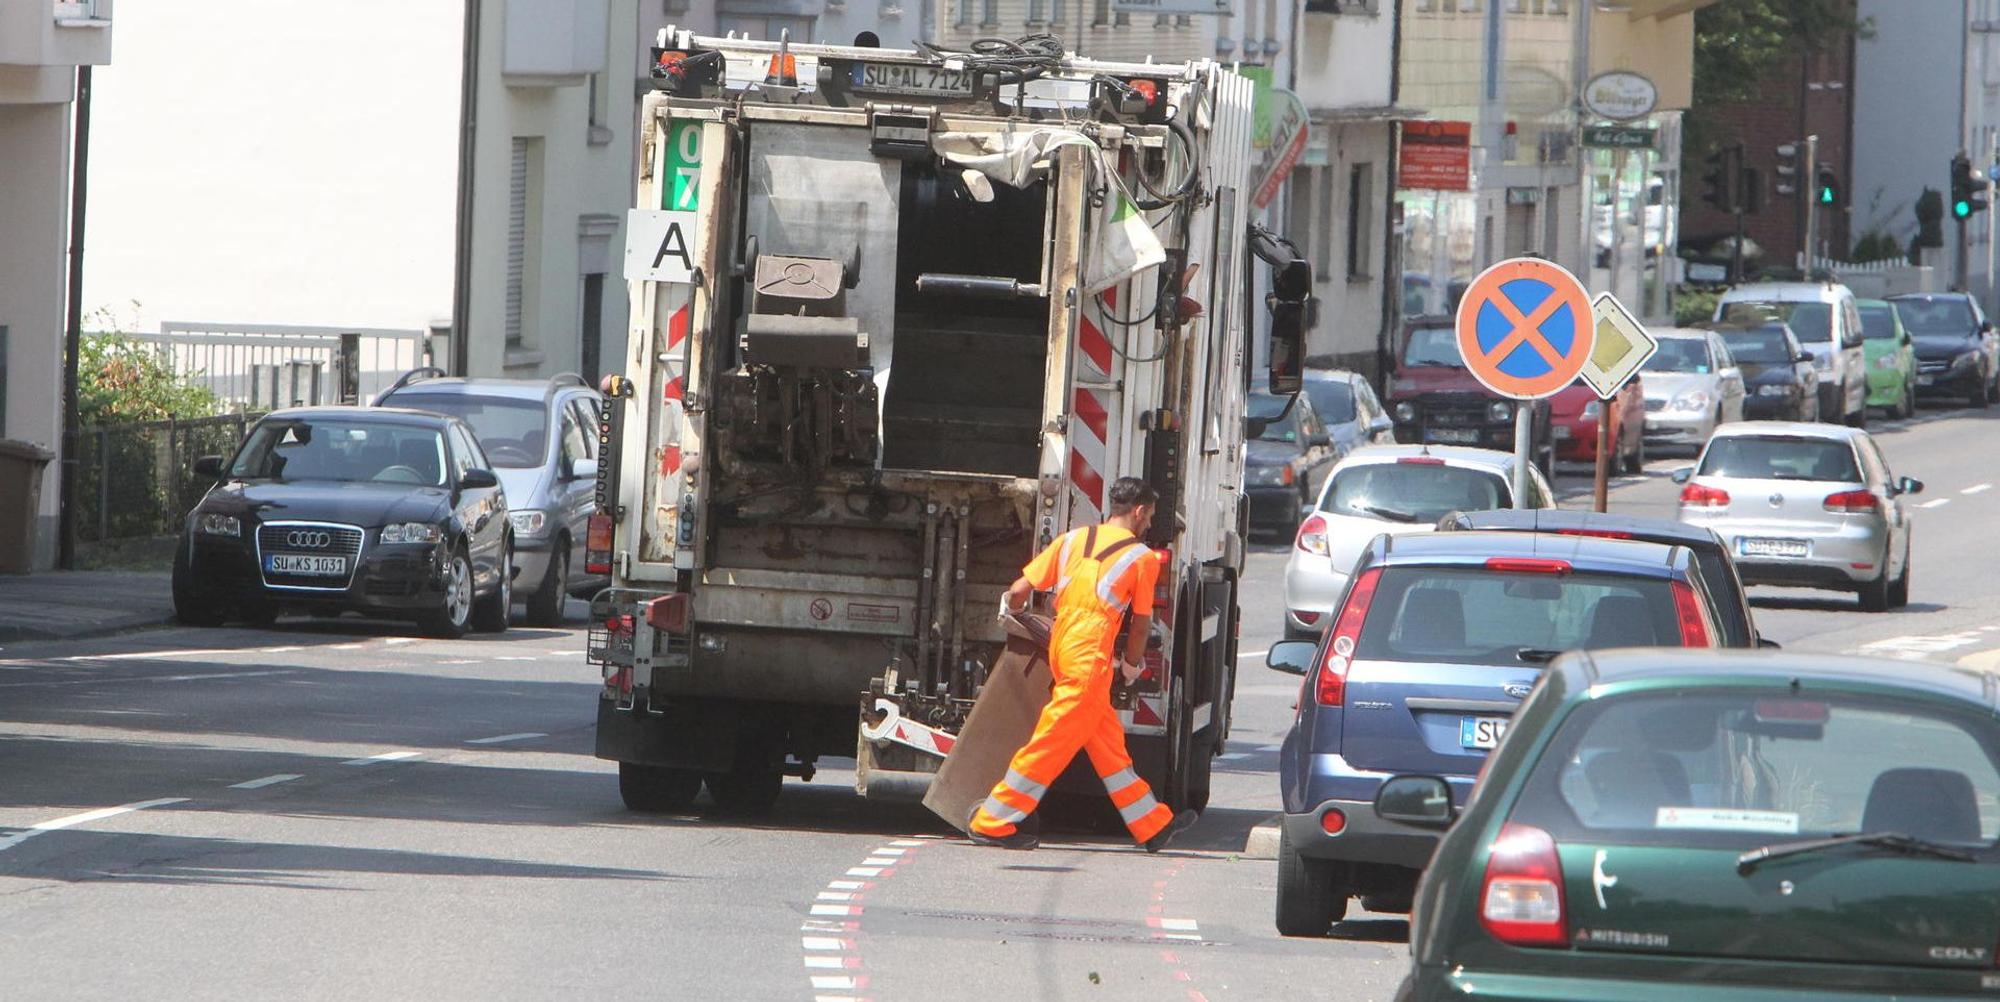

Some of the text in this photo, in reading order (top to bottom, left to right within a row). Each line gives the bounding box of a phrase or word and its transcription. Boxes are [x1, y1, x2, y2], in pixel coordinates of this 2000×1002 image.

[865, 65, 970, 91] SU AL 7124
[651, 222, 693, 270] A
[273, 556, 343, 572] SU KS 1031
[1591, 929, 1670, 947] MITSUBISHI
[1929, 946, 1987, 960] COLT
